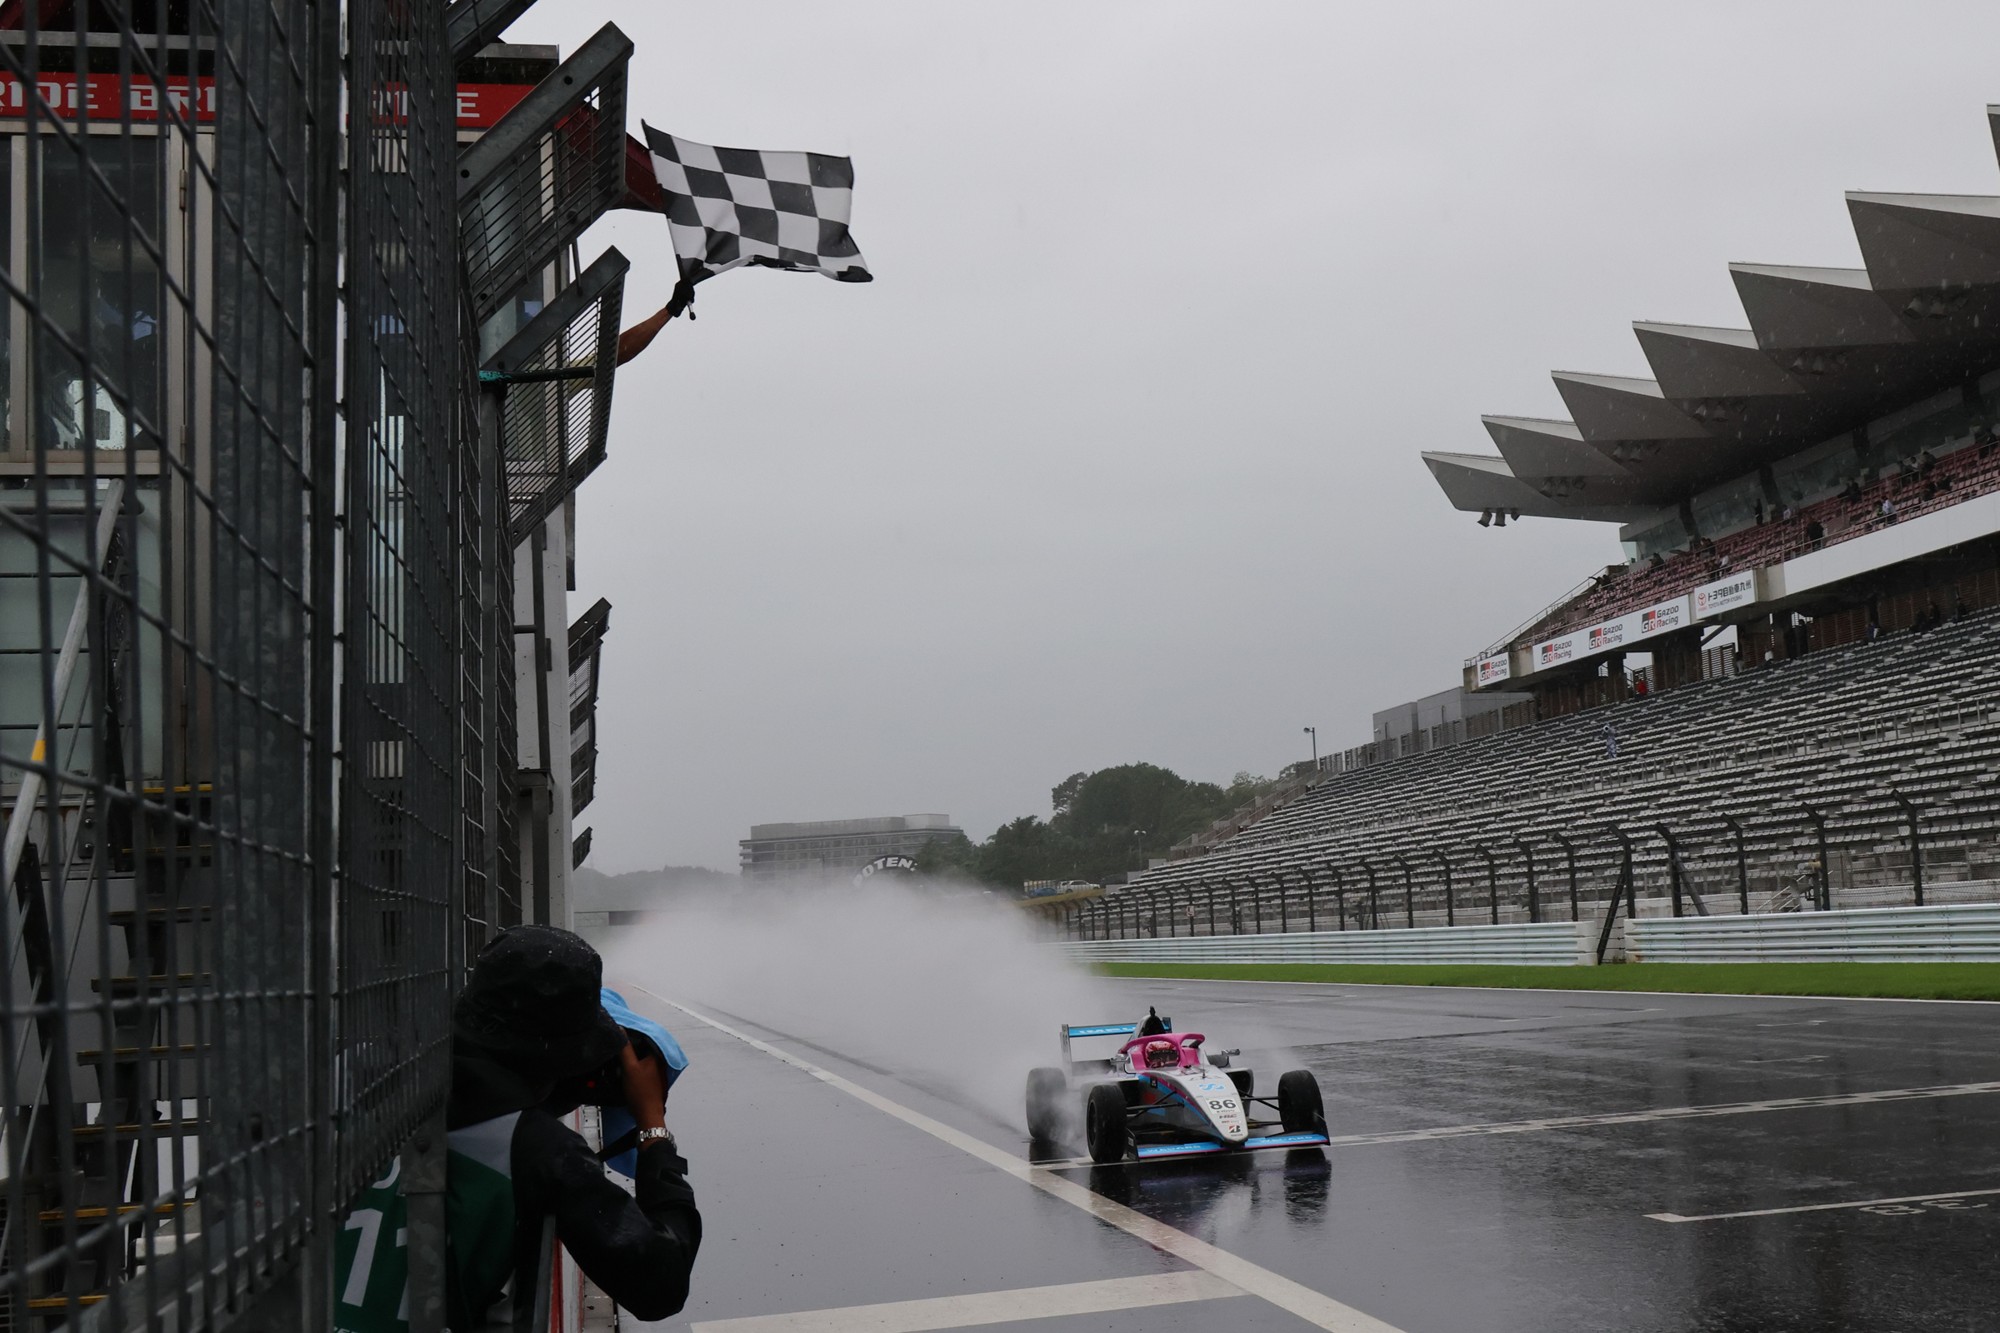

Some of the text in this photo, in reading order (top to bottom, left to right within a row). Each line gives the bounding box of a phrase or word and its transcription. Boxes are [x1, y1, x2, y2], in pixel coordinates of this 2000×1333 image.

[1656, 605, 1679, 618] GAZOO
[1656, 615, 1679, 628] Racing
[1602, 623, 1623, 636] GAZOO
[1602, 633, 1623, 645] Racing
[1553, 640, 1572, 652] GAZOO
[1553, 650, 1572, 660] Racing
[1490, 658, 1508, 669] GAZOO
[1490, 667, 1508, 678] Racing
[1209, 1099, 1237, 1110] 86
